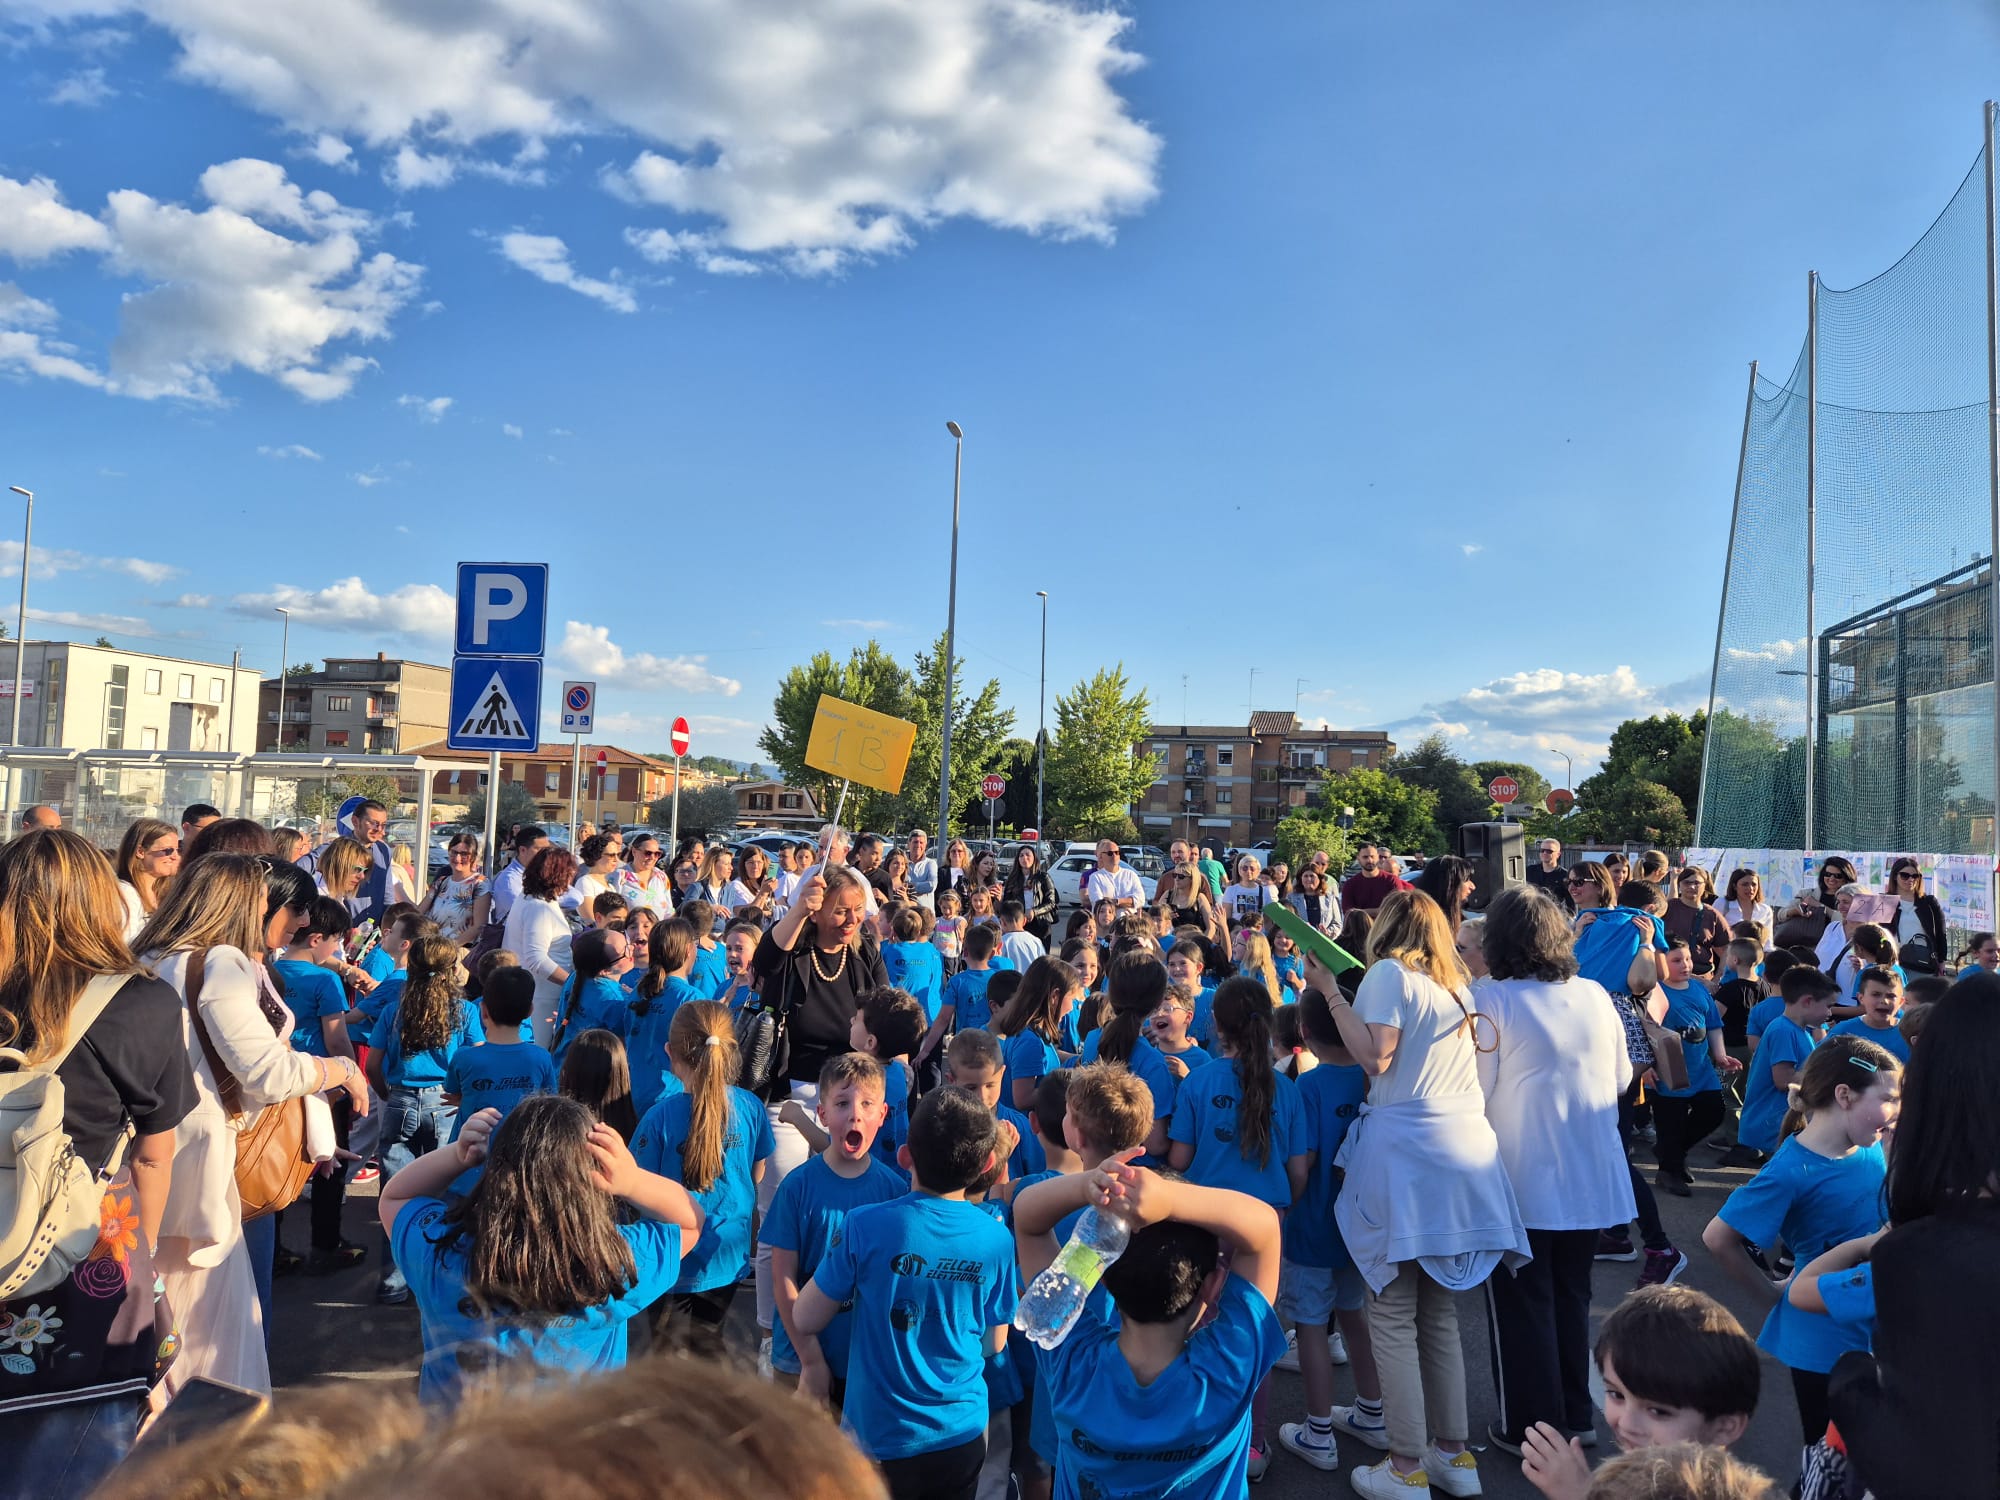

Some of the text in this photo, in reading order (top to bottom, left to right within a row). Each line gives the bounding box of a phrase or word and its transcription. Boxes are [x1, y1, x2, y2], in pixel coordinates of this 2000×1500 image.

[473, 573, 527, 645] P
[983, 782, 1003, 791] STOP
[1491, 785, 1516, 796] STOP
